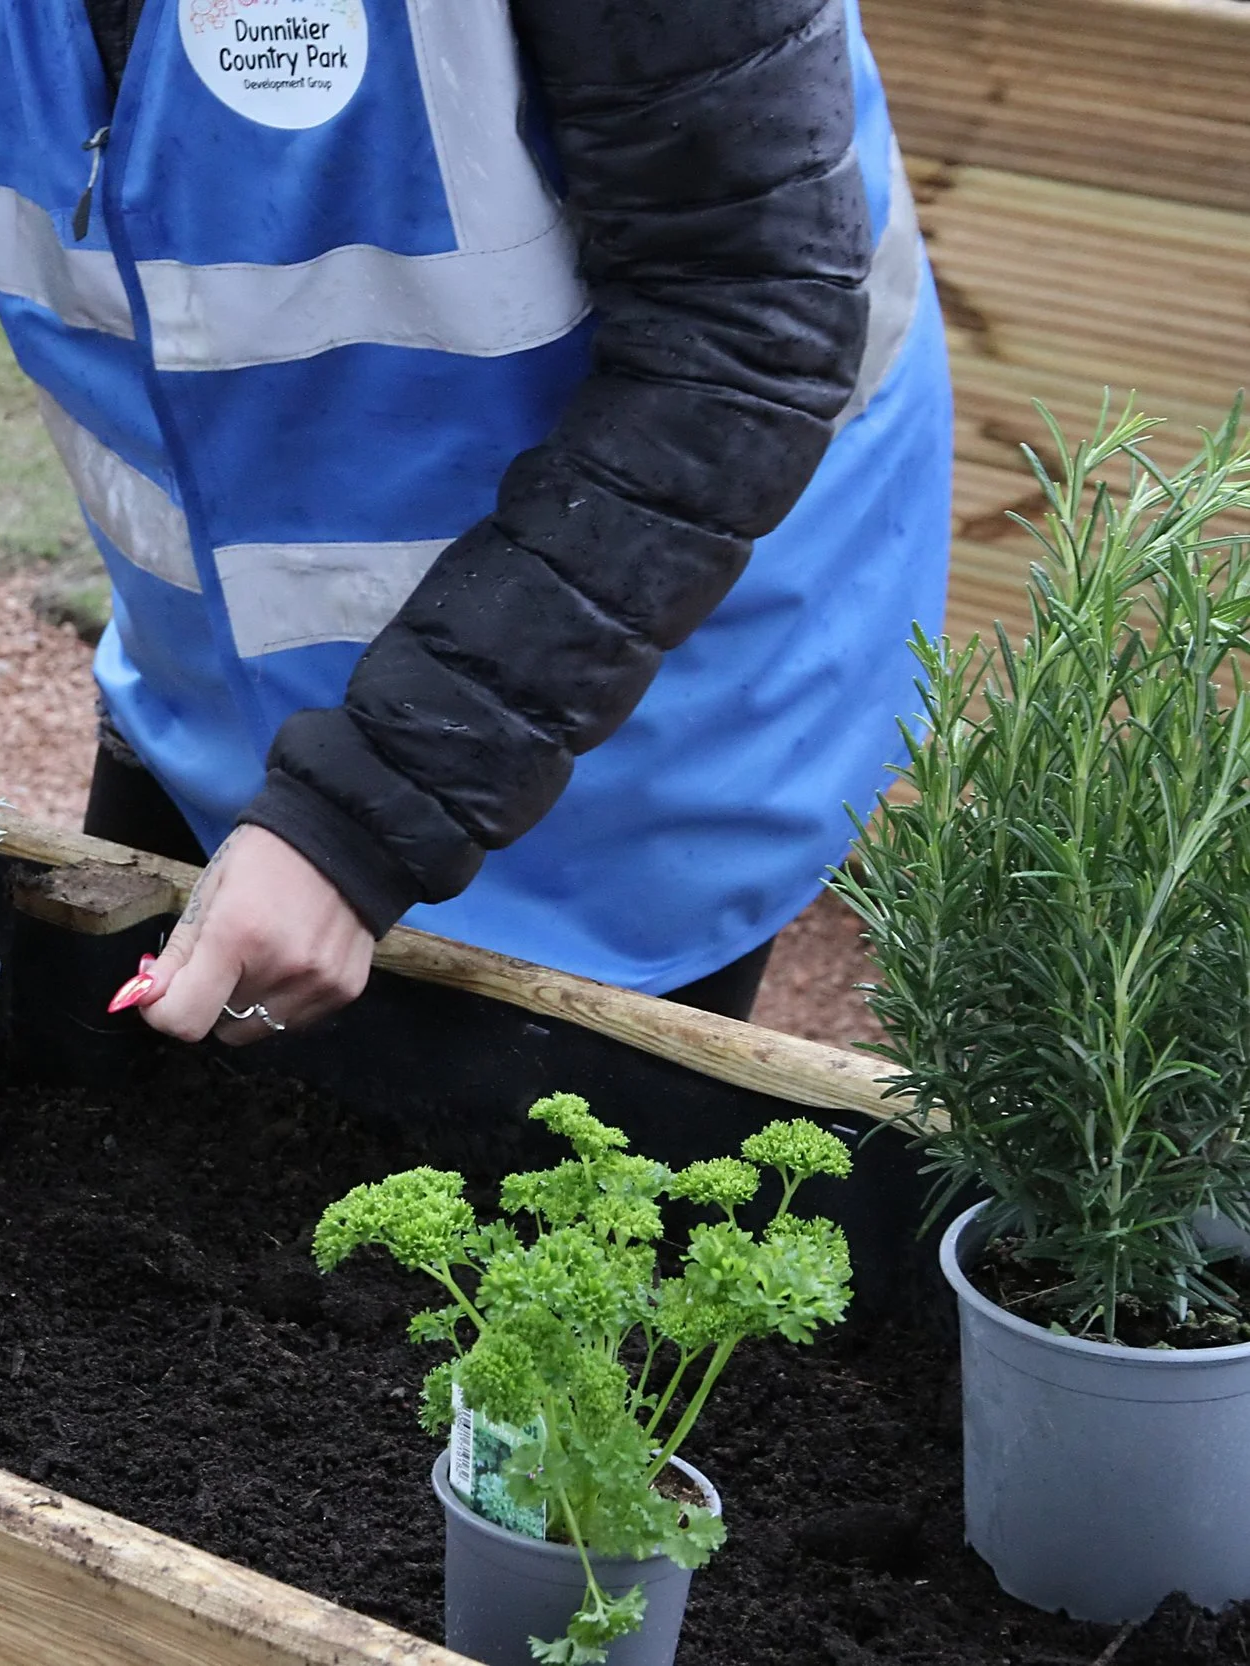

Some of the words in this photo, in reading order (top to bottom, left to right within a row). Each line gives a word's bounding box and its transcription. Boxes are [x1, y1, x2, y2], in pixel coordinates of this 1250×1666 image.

[235, 17, 330, 42] Dunnikier
[219, 46, 298, 76] Country
[306, 44, 348, 69] Park
[243, 77, 305, 91] Development
[307, 77, 333, 91] Group
